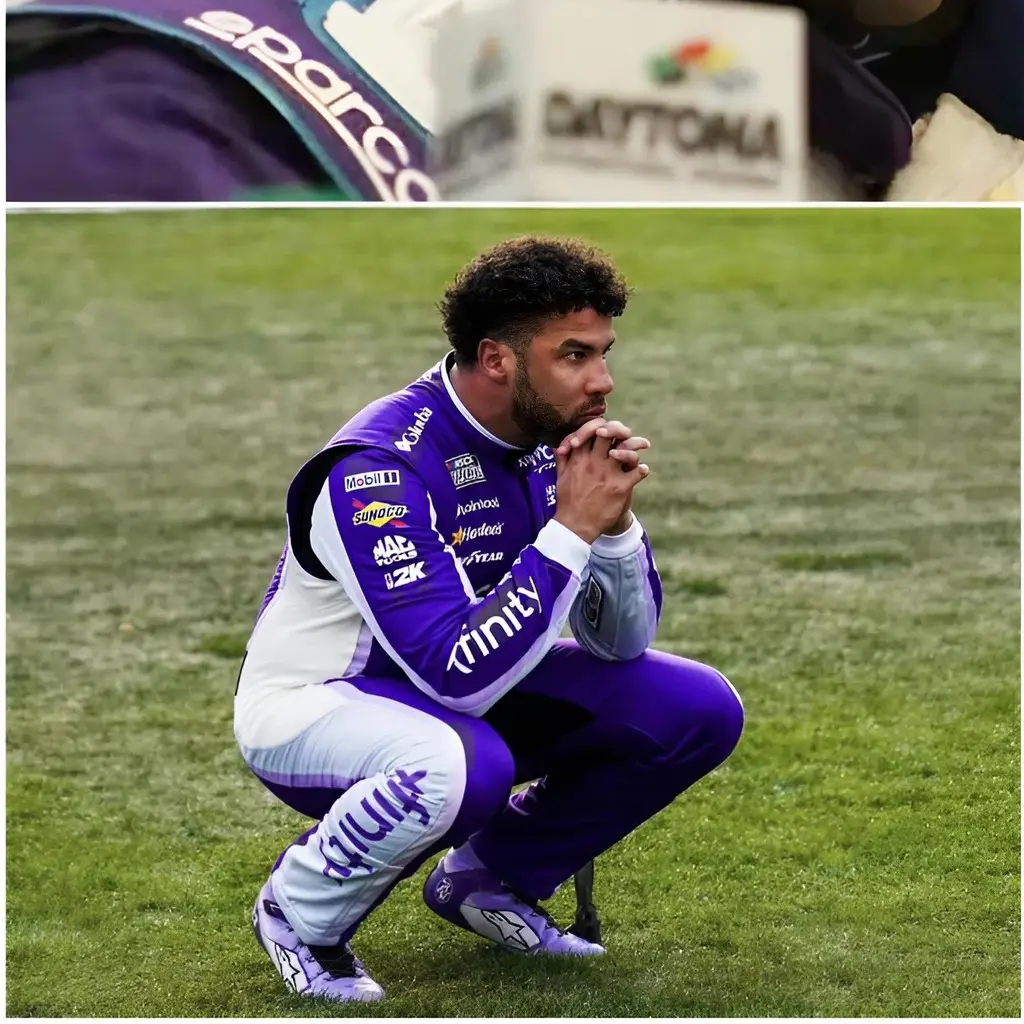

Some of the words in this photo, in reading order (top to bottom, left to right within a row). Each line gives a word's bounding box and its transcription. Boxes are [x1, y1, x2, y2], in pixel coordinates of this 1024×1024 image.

[183, 10, 438, 201] sparco
[544, 89, 781, 163] DAYTONA
[346, 473, 381, 490] Mobil
[354, 507, 405, 524] SUNOCO
[373, 535, 415, 560] MAC
[393, 561, 427, 588] 2K
